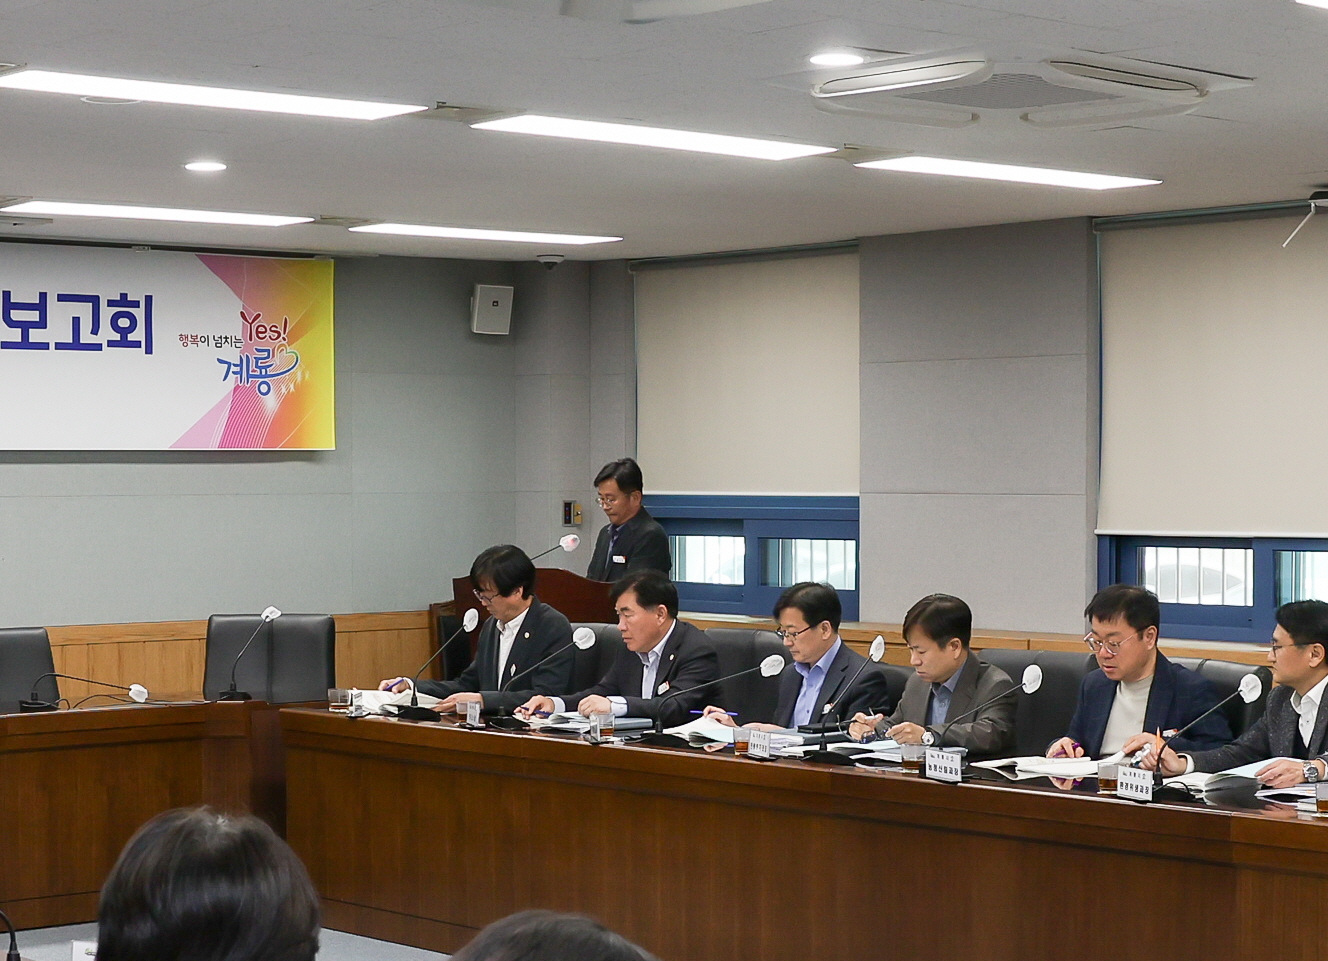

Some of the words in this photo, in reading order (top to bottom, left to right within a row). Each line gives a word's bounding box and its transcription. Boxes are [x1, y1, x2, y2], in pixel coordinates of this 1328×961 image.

[0, 289, 154, 355] 보고회
[178, 333, 210, 348] 행복이
[212, 334, 244, 349] 넘치는
[239, 310, 288, 342] Yes!
[216, 347, 276, 397] 계룡
